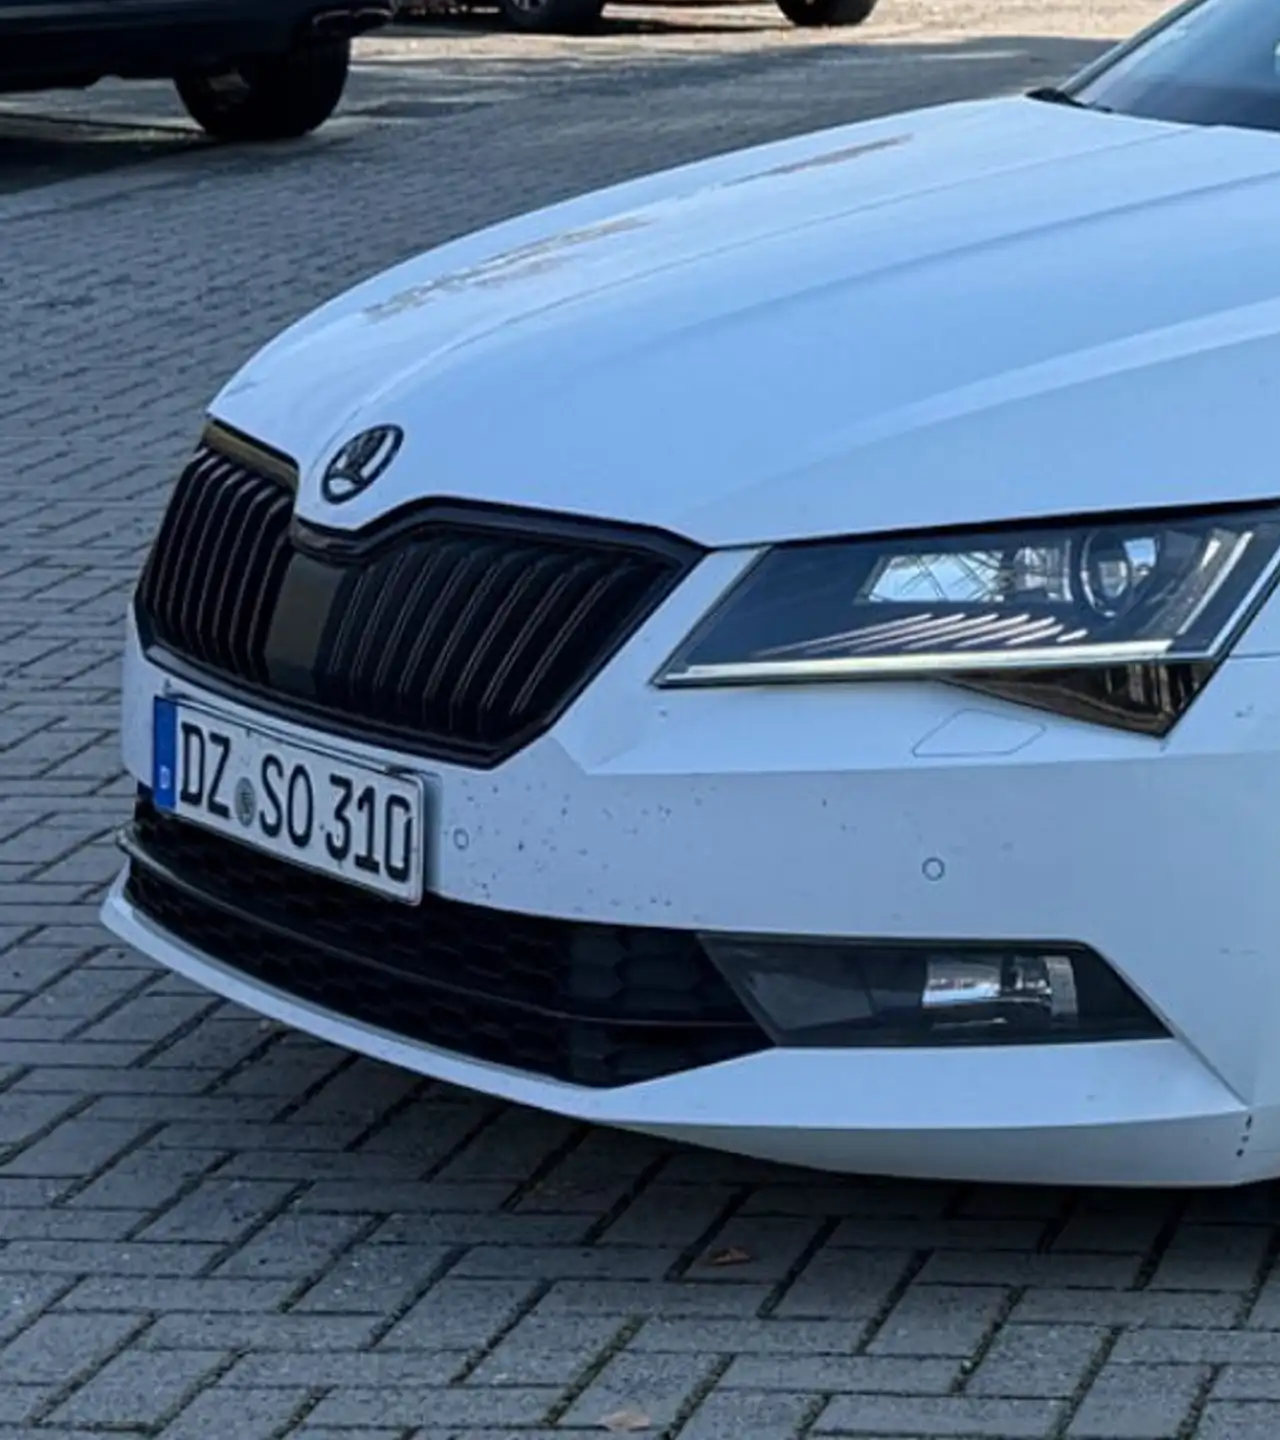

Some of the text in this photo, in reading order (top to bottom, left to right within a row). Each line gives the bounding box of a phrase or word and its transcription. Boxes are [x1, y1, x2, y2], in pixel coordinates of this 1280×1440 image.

[180, 721, 413, 884] DZ SO 310
